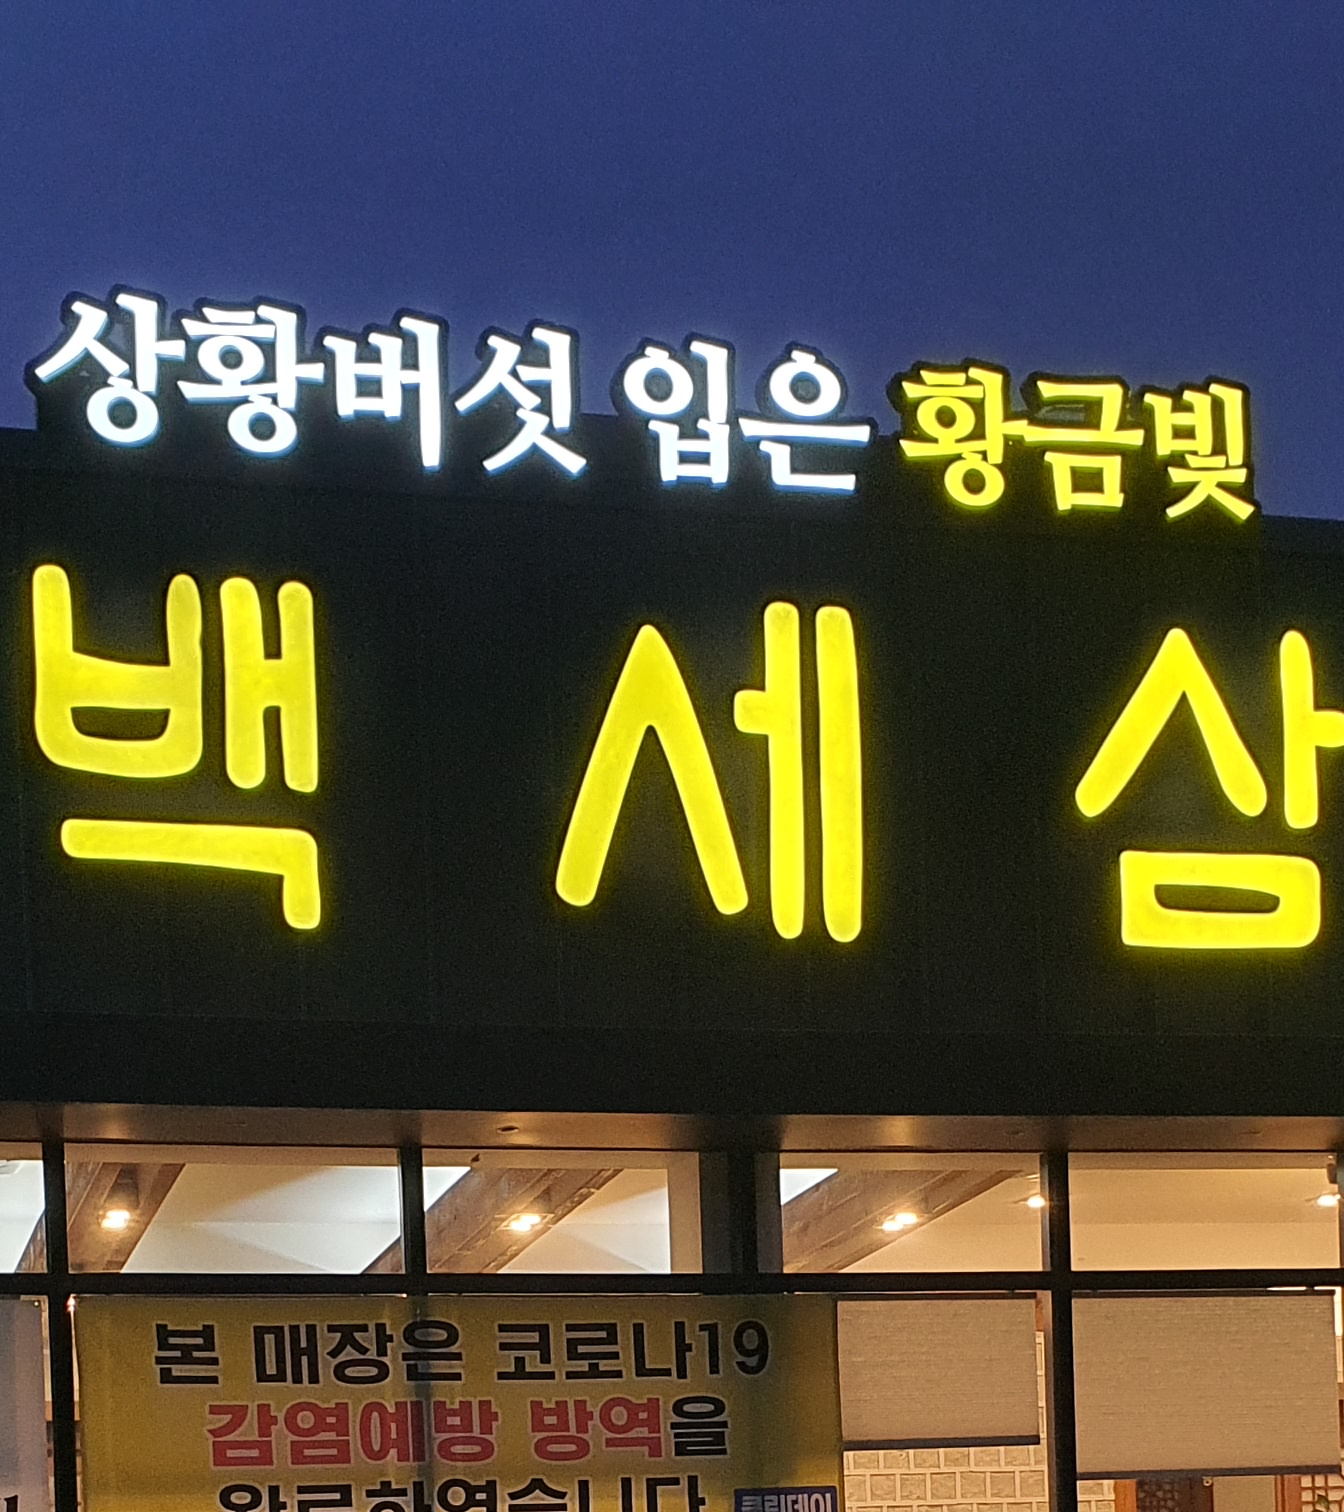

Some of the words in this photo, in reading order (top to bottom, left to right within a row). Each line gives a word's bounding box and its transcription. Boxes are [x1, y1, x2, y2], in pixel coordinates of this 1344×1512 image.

[34, 290, 590, 478] 상황버섯
[622, 340, 871, 493] 입은
[898, 361, 1257, 523] 황금빛
[153, 1321, 221, 1387] 본
[252, 1319, 463, 1388] 매장은
[495, 1317, 773, 1384] 코로나19
[206, 1397, 501, 1470] 감염예방
[528, 1394, 733, 1461] 방역을
